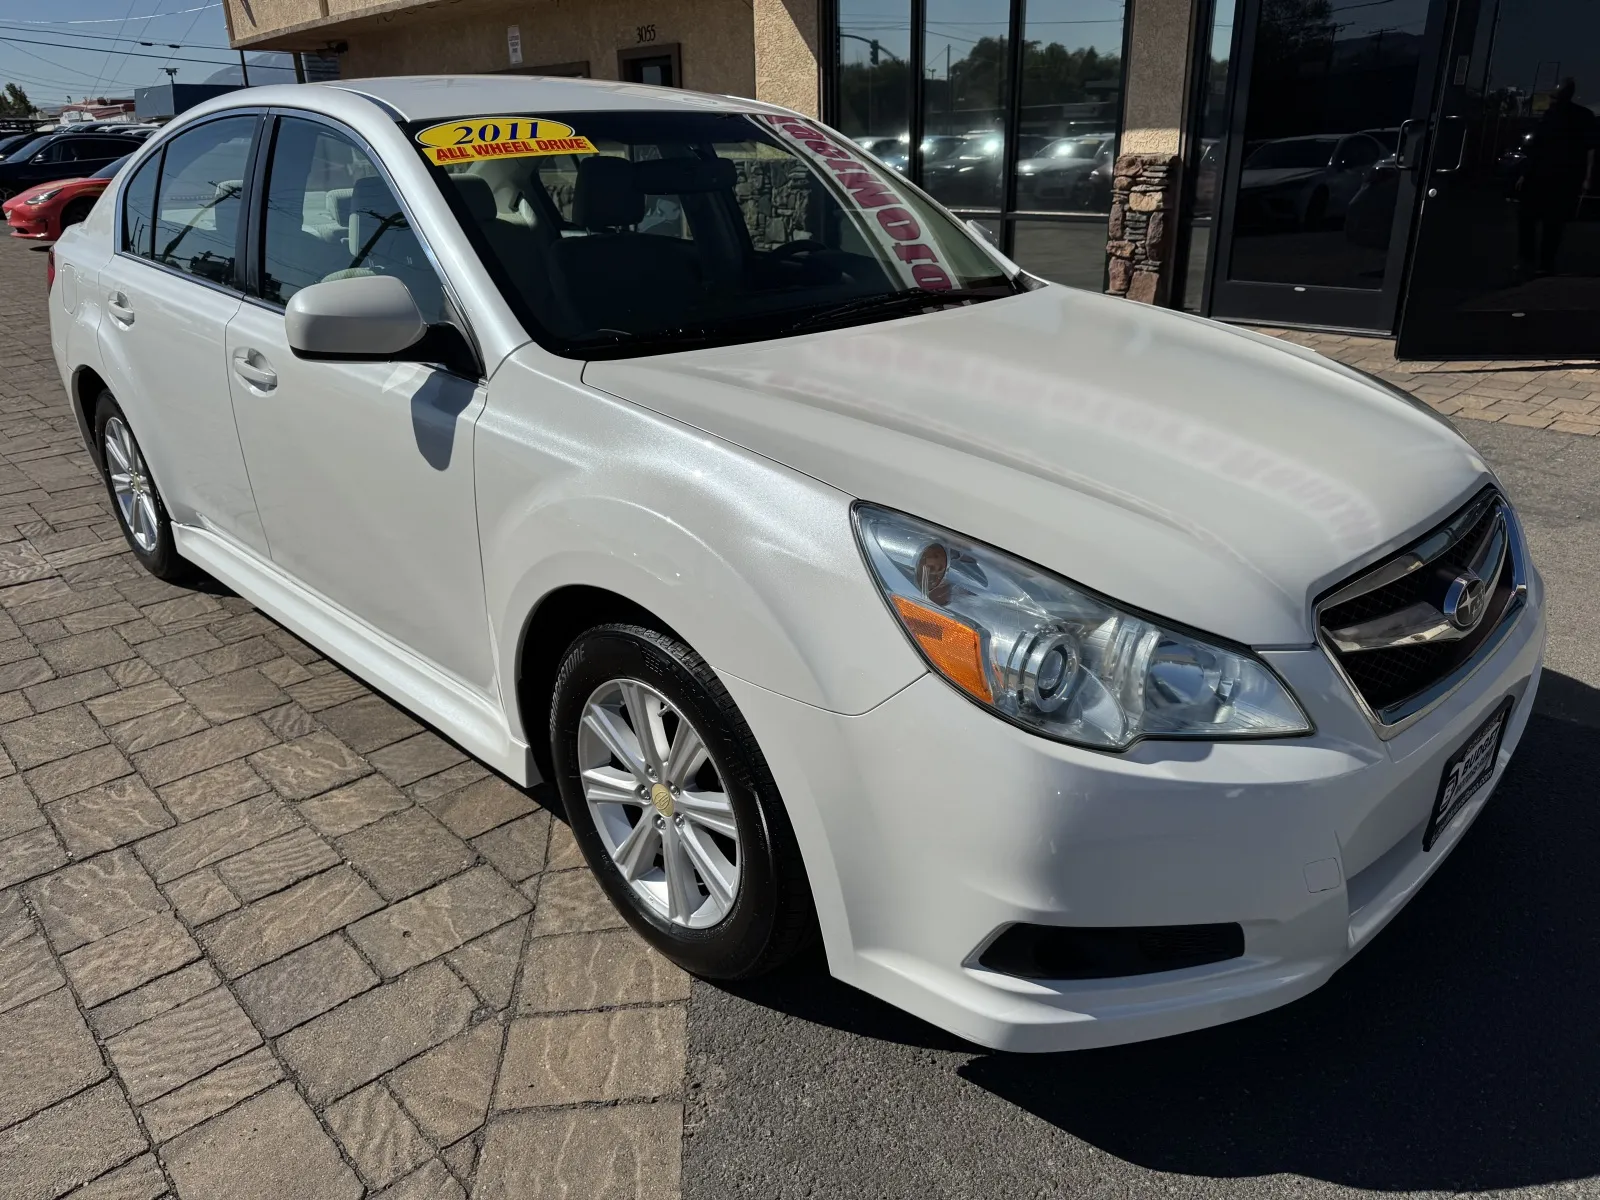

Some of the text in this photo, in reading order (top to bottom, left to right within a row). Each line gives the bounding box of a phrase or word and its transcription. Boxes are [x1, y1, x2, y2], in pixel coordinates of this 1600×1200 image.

[636, 24, 656, 44] 3055
[453, 121, 543, 146] 2011
[435, 138, 587, 162] ALL WHEEL DRIVE
